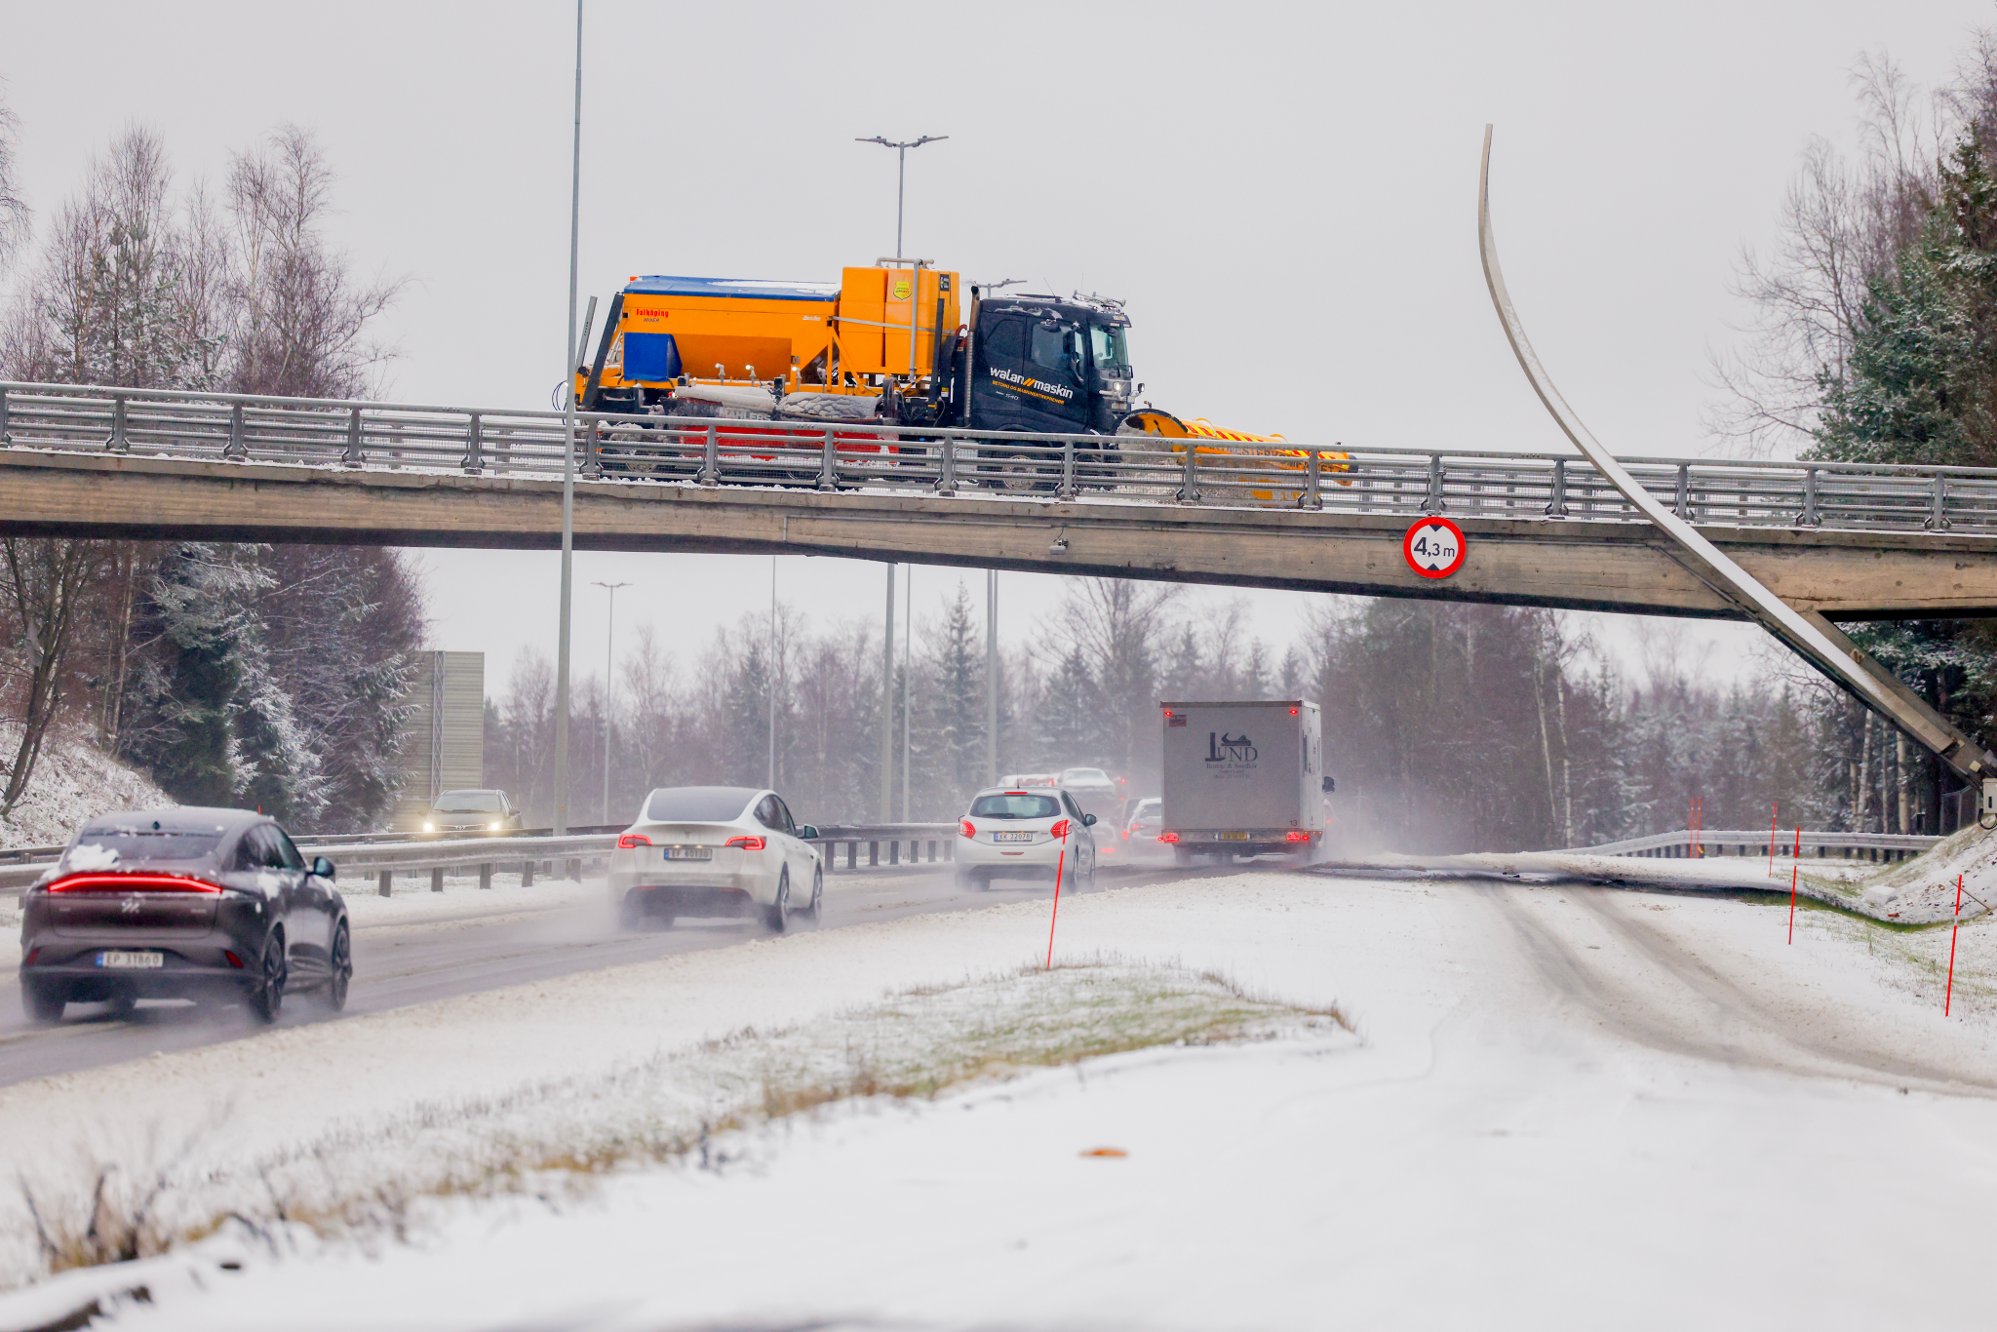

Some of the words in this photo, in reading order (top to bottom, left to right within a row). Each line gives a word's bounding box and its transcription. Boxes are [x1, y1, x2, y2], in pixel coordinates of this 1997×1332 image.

[1413, 536, 1441, 558] 4,3
[1443, 547, 1455, 558] m
[1204, 731, 1258, 762] LUND
